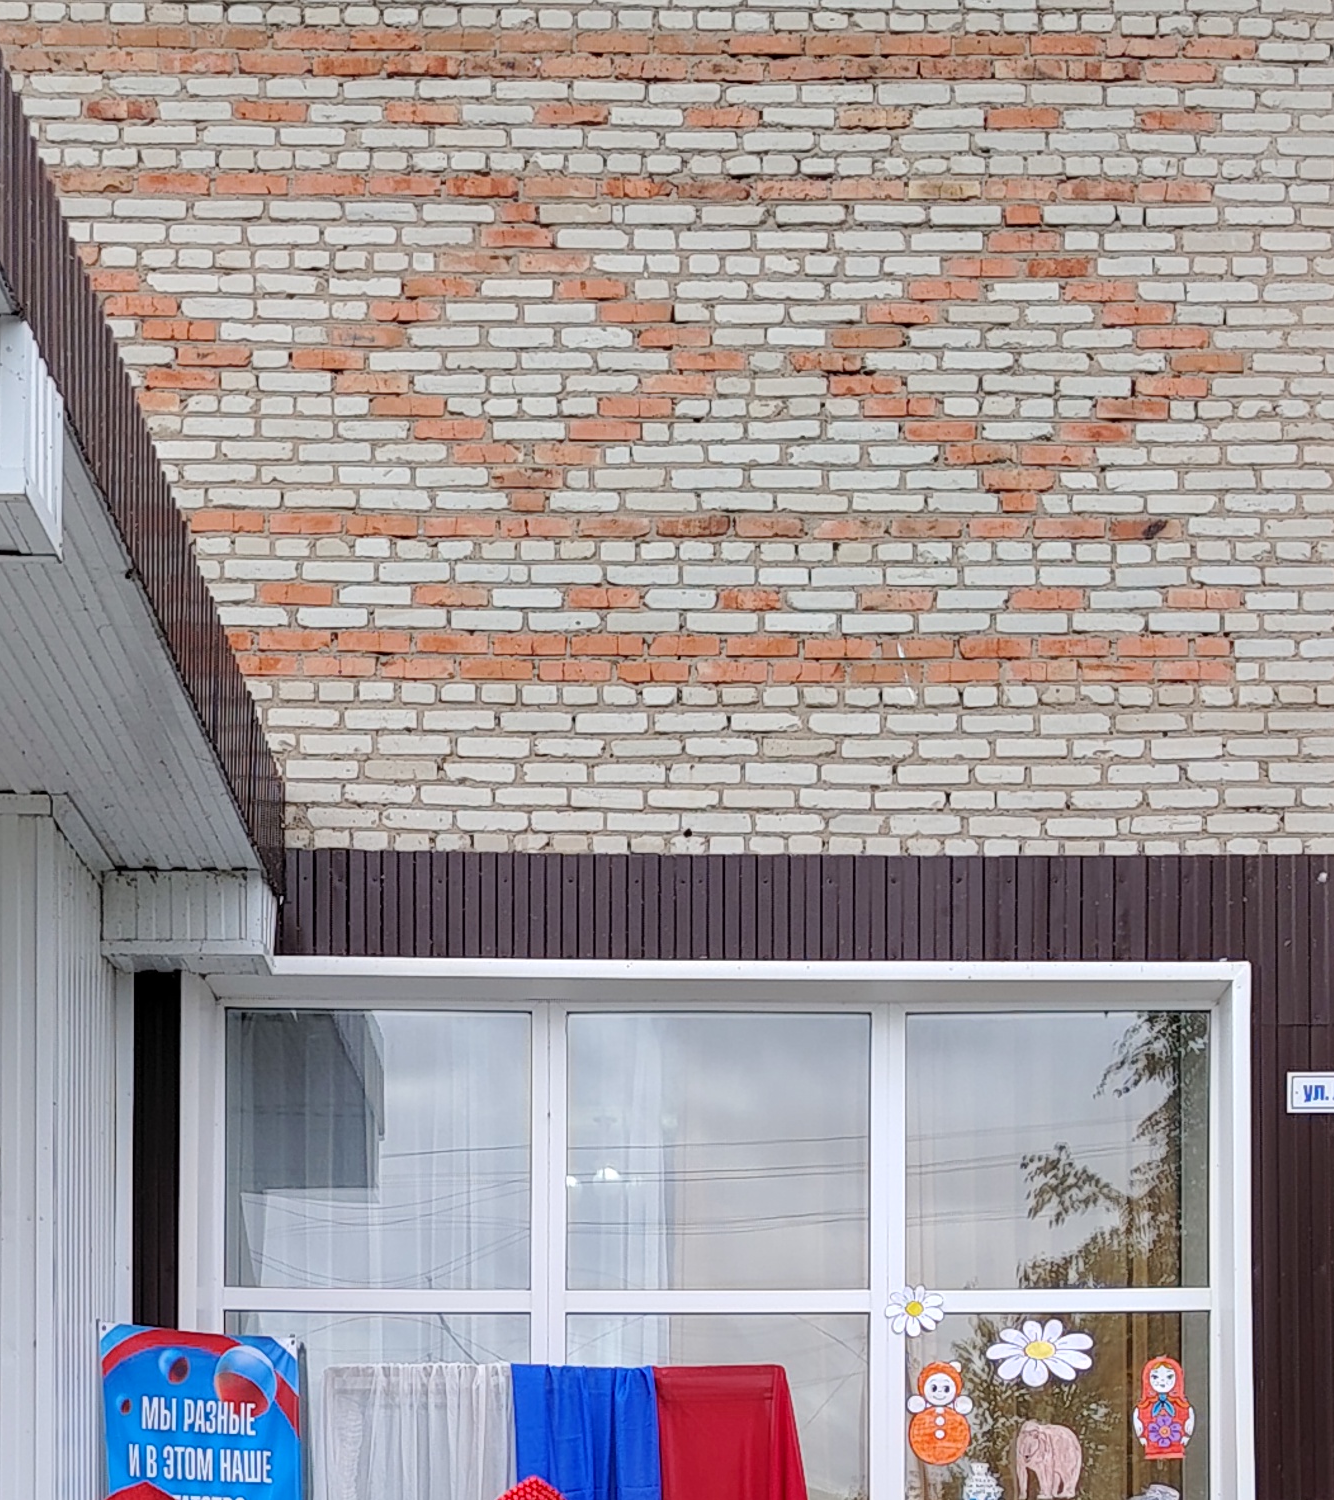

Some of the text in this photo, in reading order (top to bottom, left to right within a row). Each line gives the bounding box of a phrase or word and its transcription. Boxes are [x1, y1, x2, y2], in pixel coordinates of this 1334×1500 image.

[1302, 1085, 1329, 1103] ул.
[141, 1395, 257, 1437] МЫ РАЗНЫЕ
[128, 1443, 273, 1485] И В ЭТОМ НАШЕ
